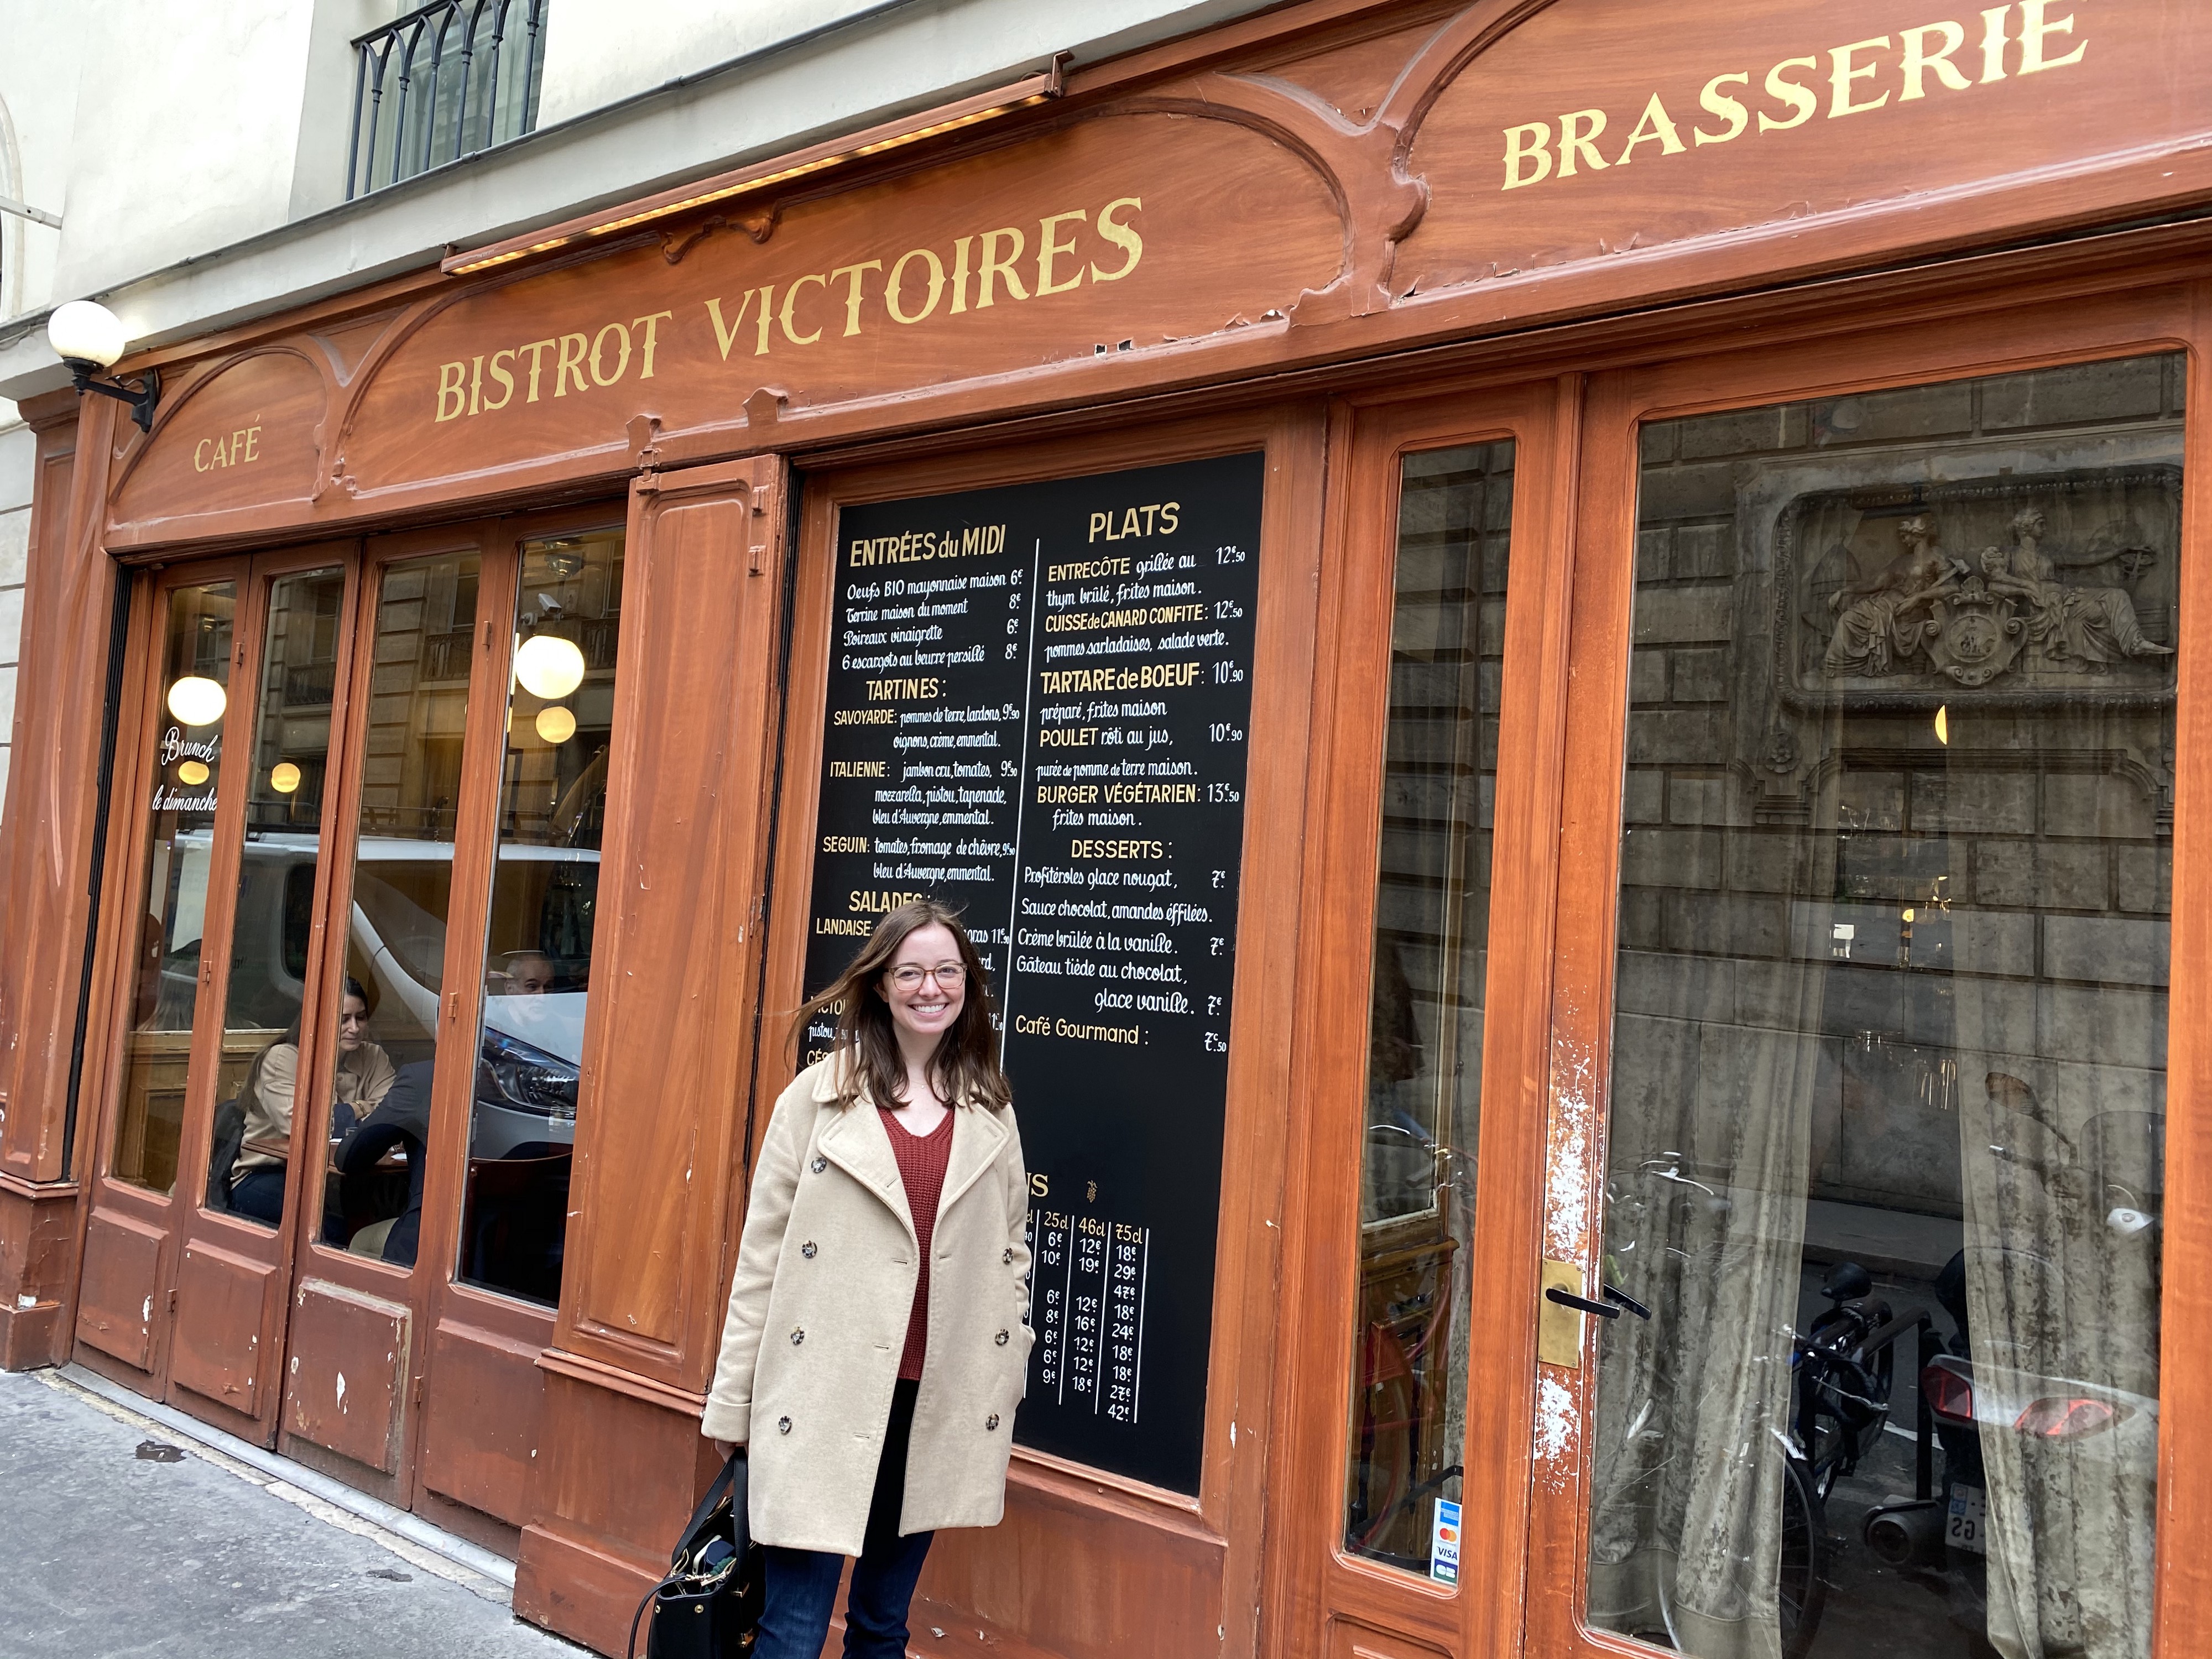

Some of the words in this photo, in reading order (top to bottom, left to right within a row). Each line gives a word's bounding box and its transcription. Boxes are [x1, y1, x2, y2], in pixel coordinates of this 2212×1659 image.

[1501, 0, 2088, 191] BRASSERIE
[435, 311, 672, 422] BISTROT
[704, 197, 1143, 361] VICTOIRES
[194, 414, 261, 472] CAFÉ
[1089, 502, 1180, 542] PLATS
[851, 531, 936, 567] ENTRÉES
[938, 531, 958, 558] du
[962, 524, 1005, 556] MIDI
[1048, 556, 1130, 582] ENTRECÔTE
[1136, 552, 1174, 581] grillée
[1179, 555, 1196, 568] au
[847, 582, 880, 602] Oeufs
[884, 580, 904, 597] BIO
[907, 575, 967, 601] mayonnaise
[970, 572, 1006, 588] maison
[1046, 590, 1076, 612] thym
[1116, 582, 1150, 606] frites
[846, 607, 878, 623] Terrine
[881, 604, 915, 620] maison
[917, 602, 930, 617] du
[931, 598, 968, 616] moment
[1046, 613, 1088, 632] CUISSE
[1088, 613, 1100, 629] de
[1101, 609, 1147, 628] CANARD
[844, 630, 887, 646] Poireaux
[891, 625, 943, 647] vinaigrette
[1044, 643, 1085, 663] pommes
[1157, 632, 1195, 650] salade
[842, 655, 850, 670] 6
[852, 651, 898, 674] escargots
[900, 655, 913, 666] au
[915, 650, 945, 665] beurre
[946, 645, 984, 667] persillé
[1041, 668, 1115, 693] TARTARE
[1117, 667, 1138, 690] de
[900, 712, 932, 728] pommes
[933, 707, 943, 722] de
[1087, 701, 1118, 722] frites
[1121, 700, 1167, 717] maison
[161, 727, 218, 765] Brunch
[1040, 728, 1098, 747] POULET
[1101, 727, 1124, 745] rôti
[1127, 731, 1144, 744] au
[900, 761, 934, 782] jambon
[1035, 760, 1062, 781] purée
[1063, 765, 1072, 776] de
[1073, 764, 1109, 781] pomme
[1110, 764, 1120, 776] de
[1120, 759, 1145, 776] terre
[152, 784, 163, 810] le
[163, 787, 217, 811] dimanche
[1037, 785, 1098, 803] BURGER
[873, 809, 891, 824] bleu
[1052, 808, 1083, 831] frites
[908, 837, 952, 859] fromage
[956, 838, 967, 855] de
[874, 862, 894, 878] bleu
[1025, 867, 1084, 888] Profitéroles
[1088, 868, 1119, 890] glace
[1021, 898, 1056, 915] Sauce
[1112, 902, 1164, 920] amandes
[1018, 928, 1054, 946] Crème
[1096, 932, 1106, 950] à
[1108, 932, 1121, 951] la
[1017, 956, 1062, 974] Gâteau
[1065, 958, 1095, 976] tiède
[1099, 965, 1118, 978] au
[1095, 988, 1133, 1013] glace
[1016, 1015, 1050, 1035] Café
[1437, 1546, 1457, 1560] VISA
